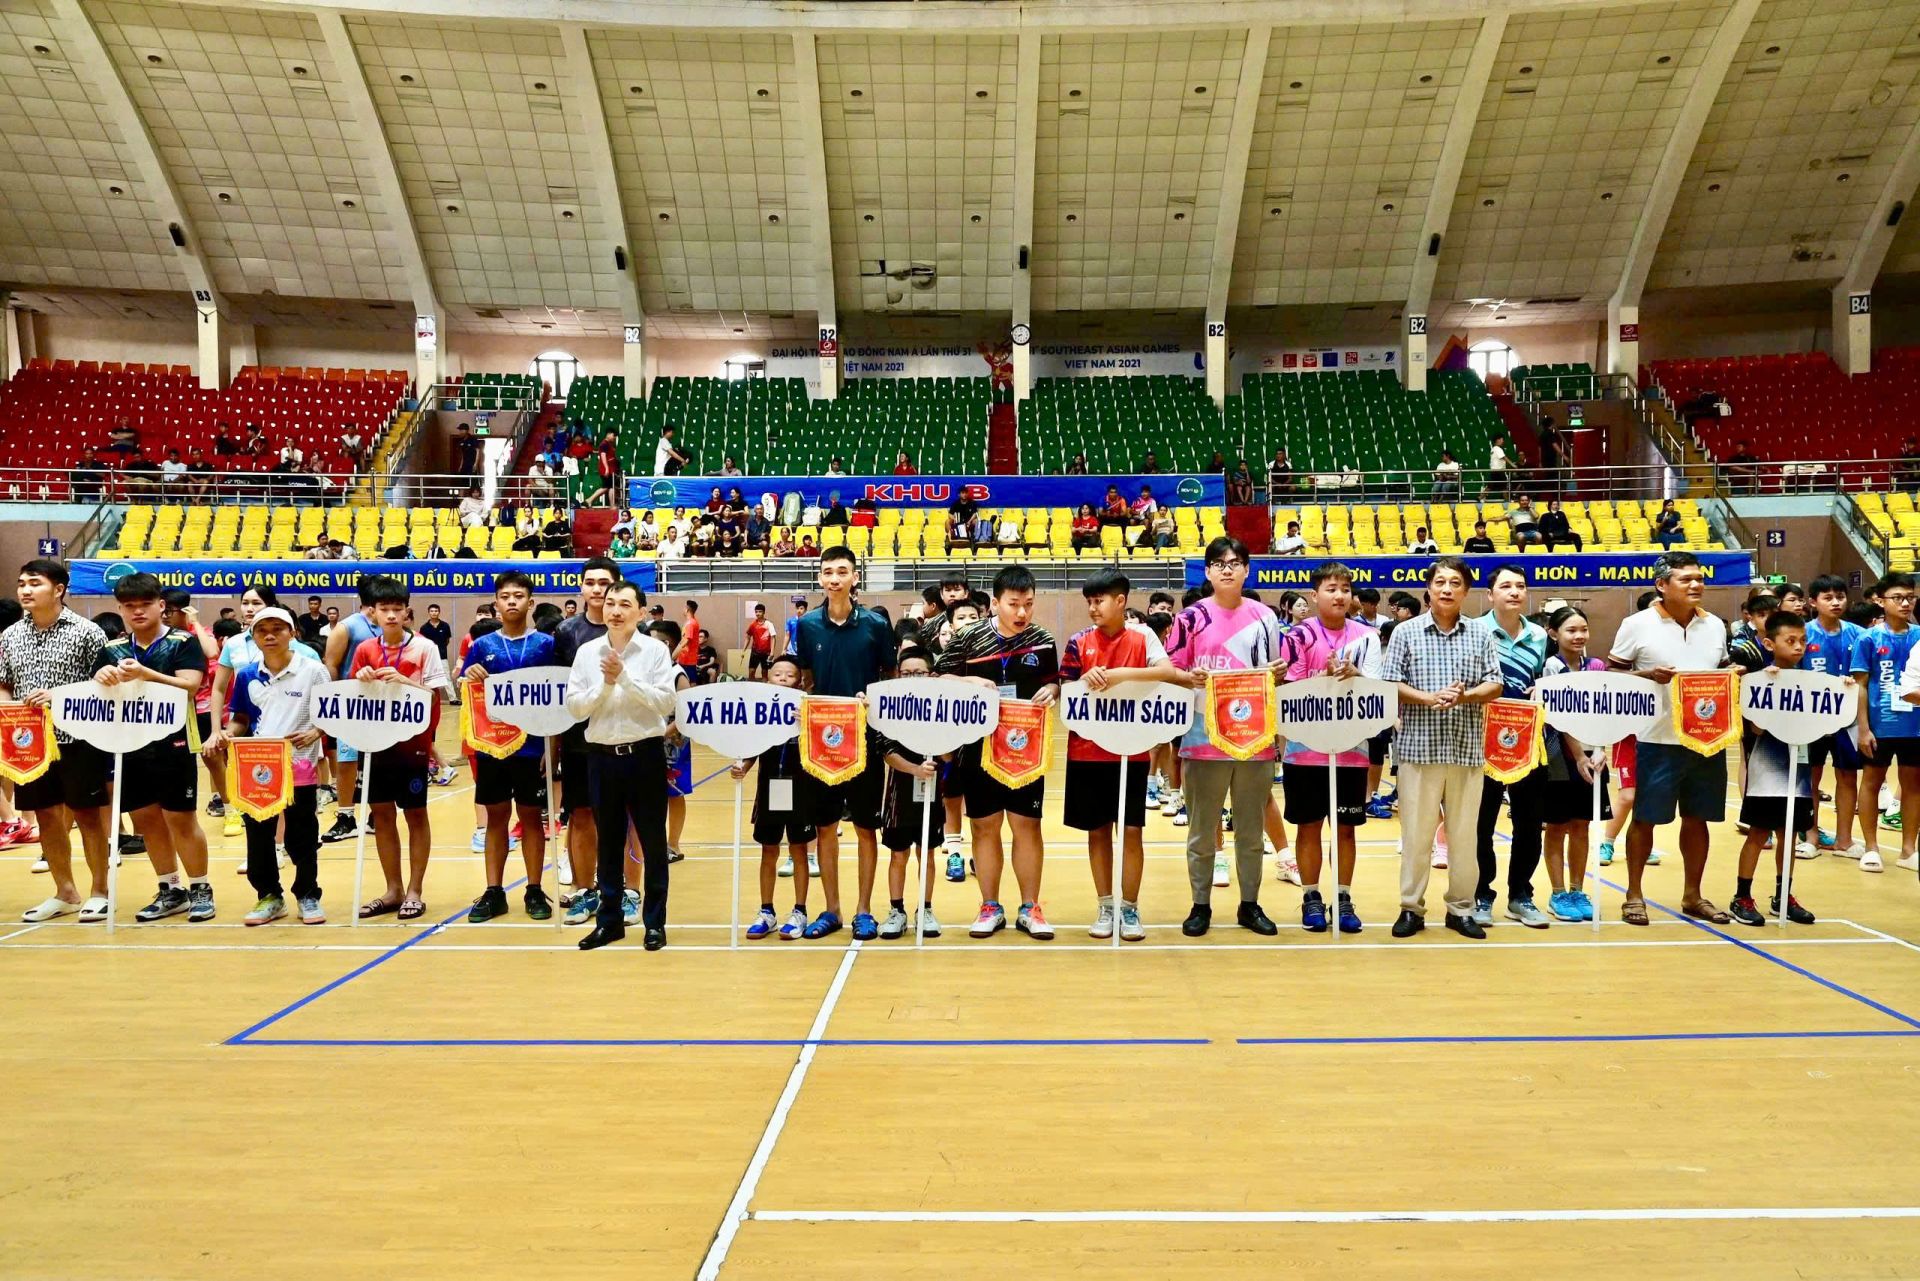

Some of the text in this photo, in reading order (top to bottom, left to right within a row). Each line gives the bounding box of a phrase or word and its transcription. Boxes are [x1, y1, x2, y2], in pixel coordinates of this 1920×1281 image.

[196, 290, 211, 301] B3
[1852, 296, 1868, 312] B4
[1208, 324, 1224, 337] B2
[1411, 319, 1424, 332] B2
[626, 327, 639, 342] B2
[820, 328, 835, 340] B2
[888, 348, 908, 356] NAM
[1041, 344, 1180, 355] SOUTHEAST ASIAN GAMES
[844, 361, 904, 373] IỆT NAM 2021
[1065, 359, 1141, 369] VIET NAM 2021
[865, 484, 990, 501] KHU B
[1769, 532, 1781, 544] 3
[41, 540, 54, 553] 4
[201, 570, 236, 587] CÁC
[283, 570, 330, 589] ĐỘNG
[335, 570, 369, 587] VIÊ
[413, 568, 447, 587] ĐẤU
[453, 573, 485, 589] ĐẠT
[551, 570, 583, 587] TÍC
[1258, 569, 1312, 583] NHAN
[1535, 565, 1577, 580] HƠN
[493, 679, 568, 706] XÃ PHÚ T
[1542, 684, 1655, 716] PHƯỜNG HẢI DƯƠNG
[1749, 684, 1773, 710] XÃ
[1779, 685, 1804, 712] HÀ
[1810, 687, 1845, 715] TÂY
[63, 694, 175, 725] PHƯỜNG KIẾN AN
[318, 693, 424, 723] XÃ VĨNH BẢO
[687, 693, 796, 726] XÃ HÀ BẮC
[935, 694, 949, 723] ÁI
[952, 694, 987, 726] QUỐC
[1067, 693, 1187, 725] XÃ NAM SÁCH
[1281, 690, 1384, 723] PHƯỜNG ĐỒ SƠN
